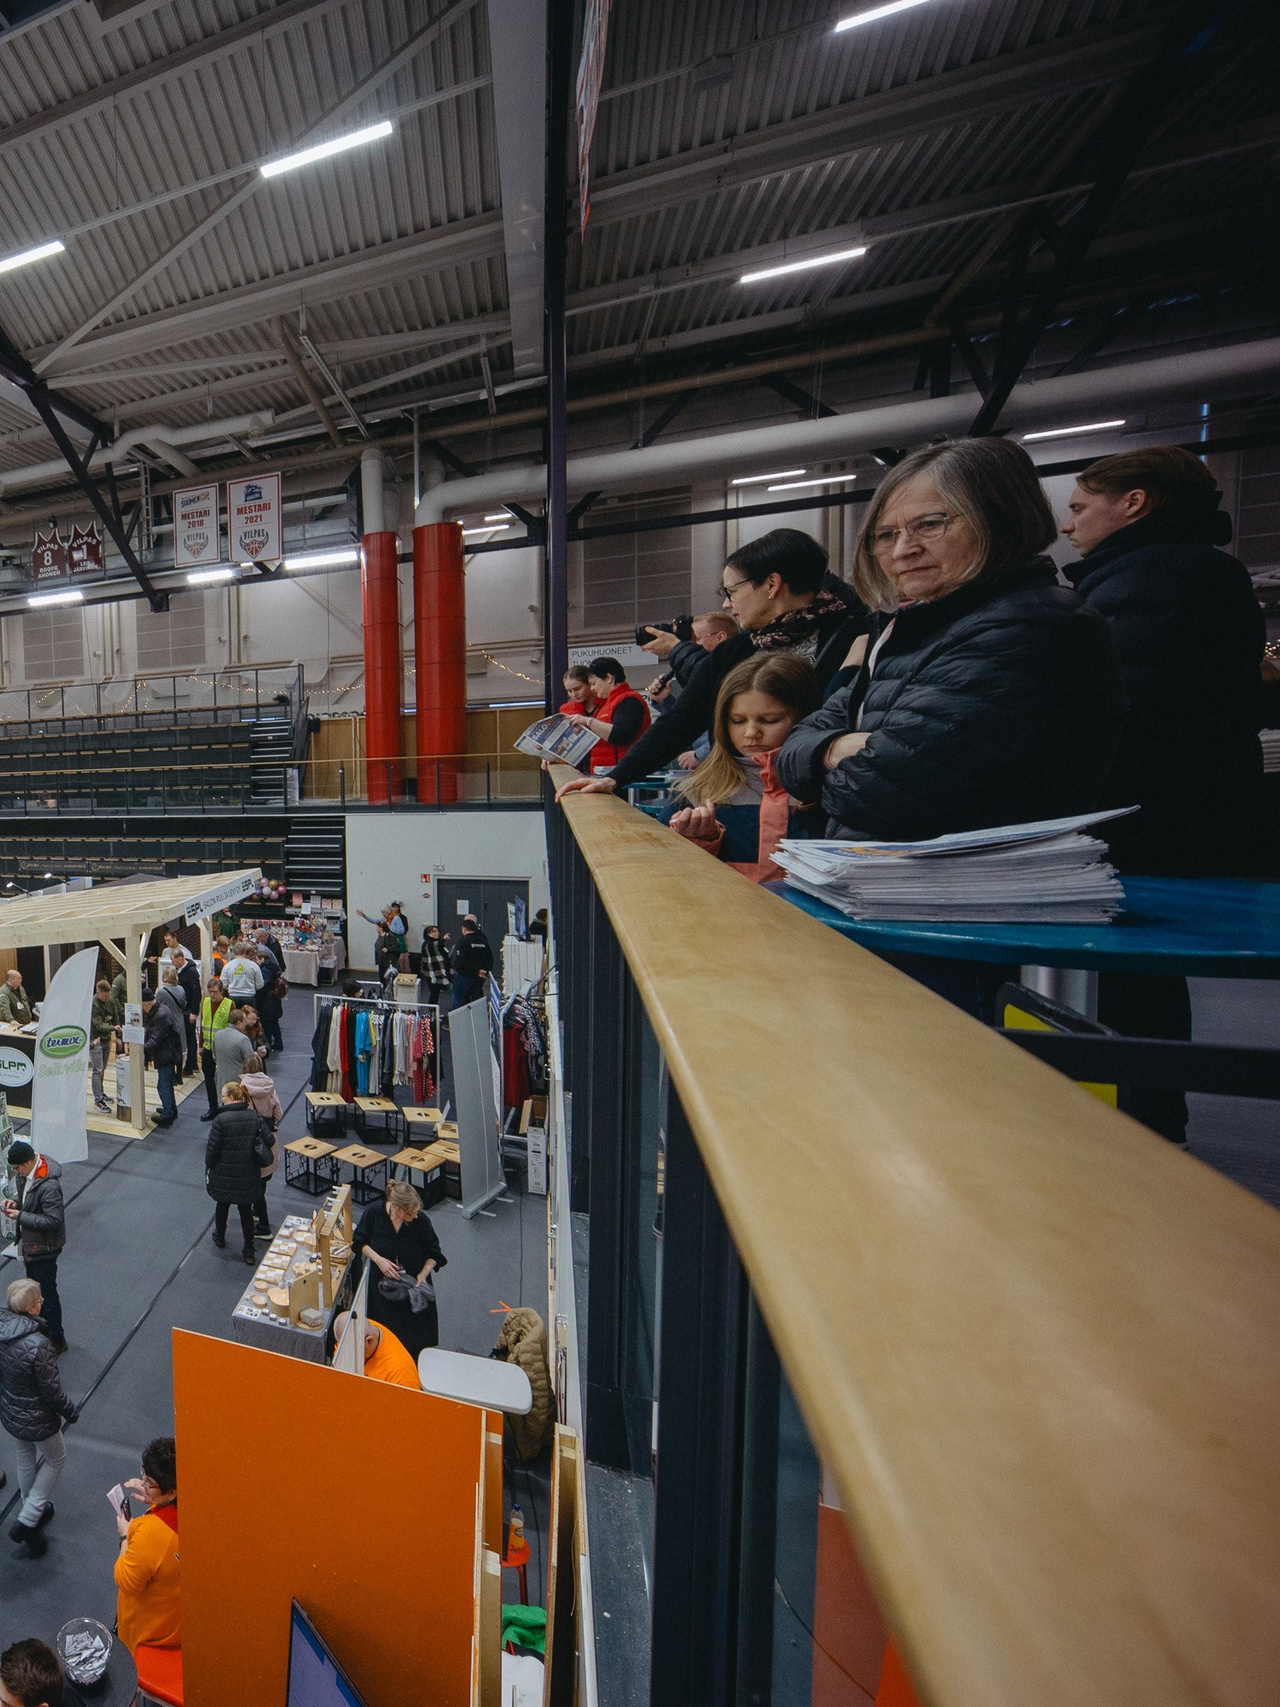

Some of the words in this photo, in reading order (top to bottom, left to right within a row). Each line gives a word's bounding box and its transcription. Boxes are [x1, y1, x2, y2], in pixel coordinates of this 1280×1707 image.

[181, 509, 211, 521] MESTARI
[236, 502, 271, 516] MESTARI
[187, 519, 204, 529] 2018
[244, 514, 263, 525] 2021
[186, 532, 205, 541] VILPAS
[243, 528, 265, 540] VILPAS
[72, 536, 97, 548] VILPAS
[36, 543, 59, 554] VILPAS
[81, 544, 88, 560] 1
[43, 550, 53, 566] 8
[38, 570, 61, 579] AHONEN
[571, 646, 633, 658] PUKUHUONEET
